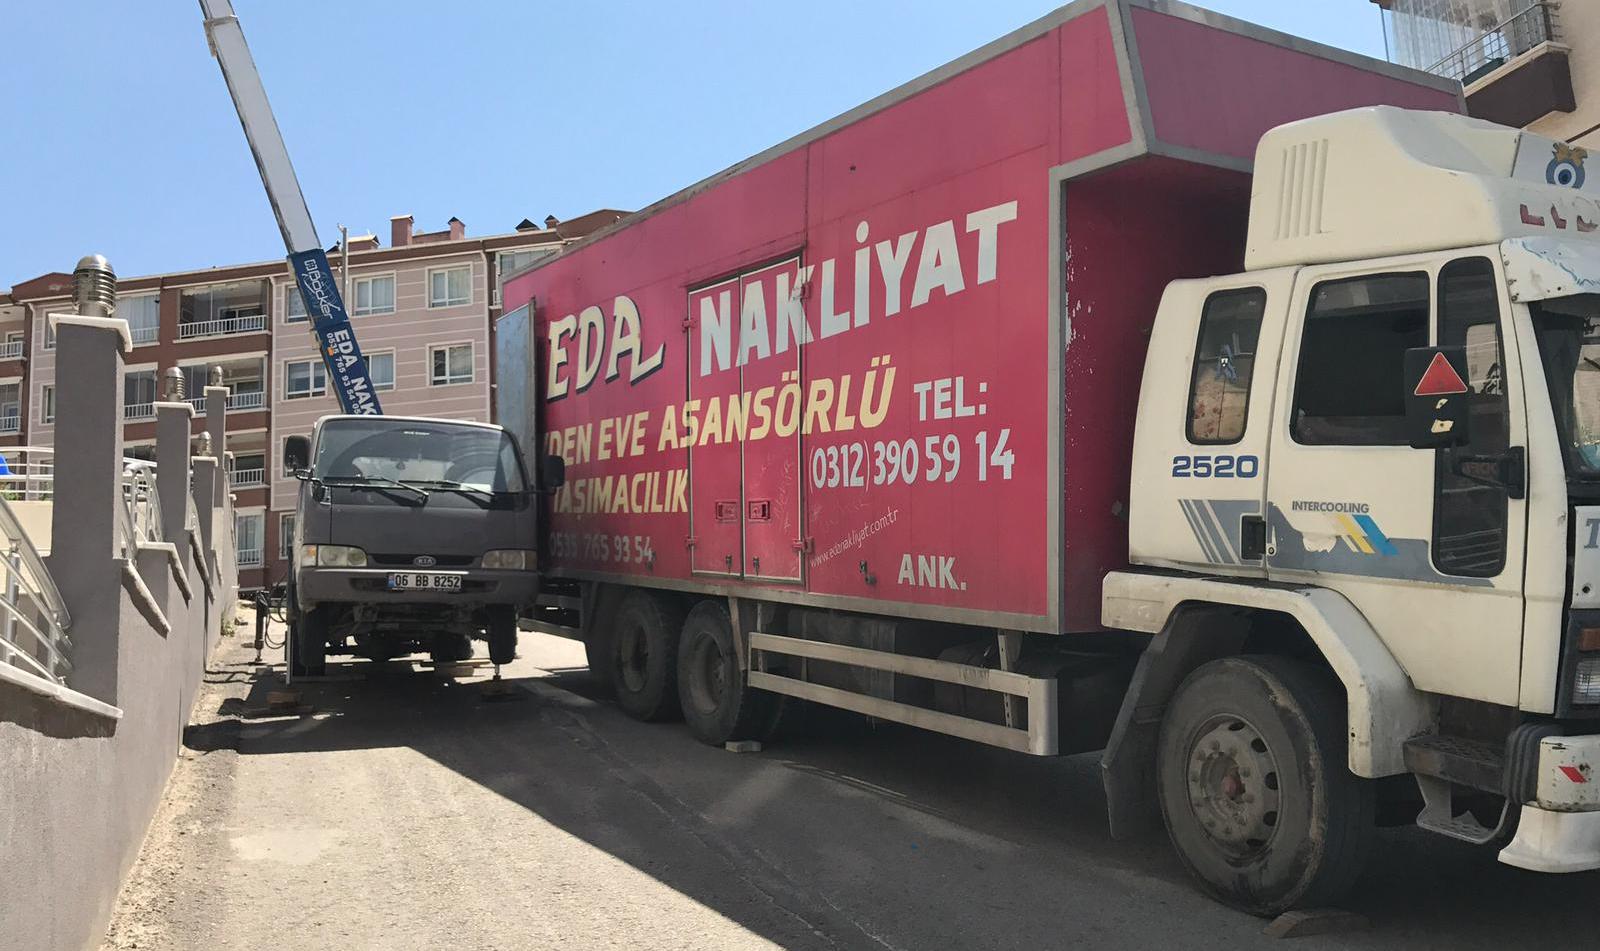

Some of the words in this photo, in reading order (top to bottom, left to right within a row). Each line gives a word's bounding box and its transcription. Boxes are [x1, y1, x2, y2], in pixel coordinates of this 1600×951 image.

[547, 295, 666, 403] EDA
[699, 200, 1018, 377] NAKLİYAT
[333, 328, 358, 368] EDA
[350, 376, 378, 415] NAK
[335, 356, 345, 374] 765
[342, 375, 351, 387] 93
[346, 389, 357, 401] 54
[913, 375, 988, 422] TEL:
[544, 422, 593, 467] DEN
[598, 411, 649, 460] EVE
[657, 354, 896, 451] ASANSÖRLÜ
[874, 438, 919, 486] 390
[925, 434, 961, 483] 59
[975, 428, 1015, 482] 14
[1172, 455, 1259, 478] 2520
[1291, 500, 1370, 514] INTERCOOLING
[418, 557, 433, 565] KIA
[584, 533, 610, 562] 765
[614, 534, 631, 563] 93
[634, 535, 653, 564] 54
[395, 574, 408, 587] 06
[415, 575, 429, 587] BB
[433, 576, 460, 588] 8252
[898, 552, 967, 592] ANK.
